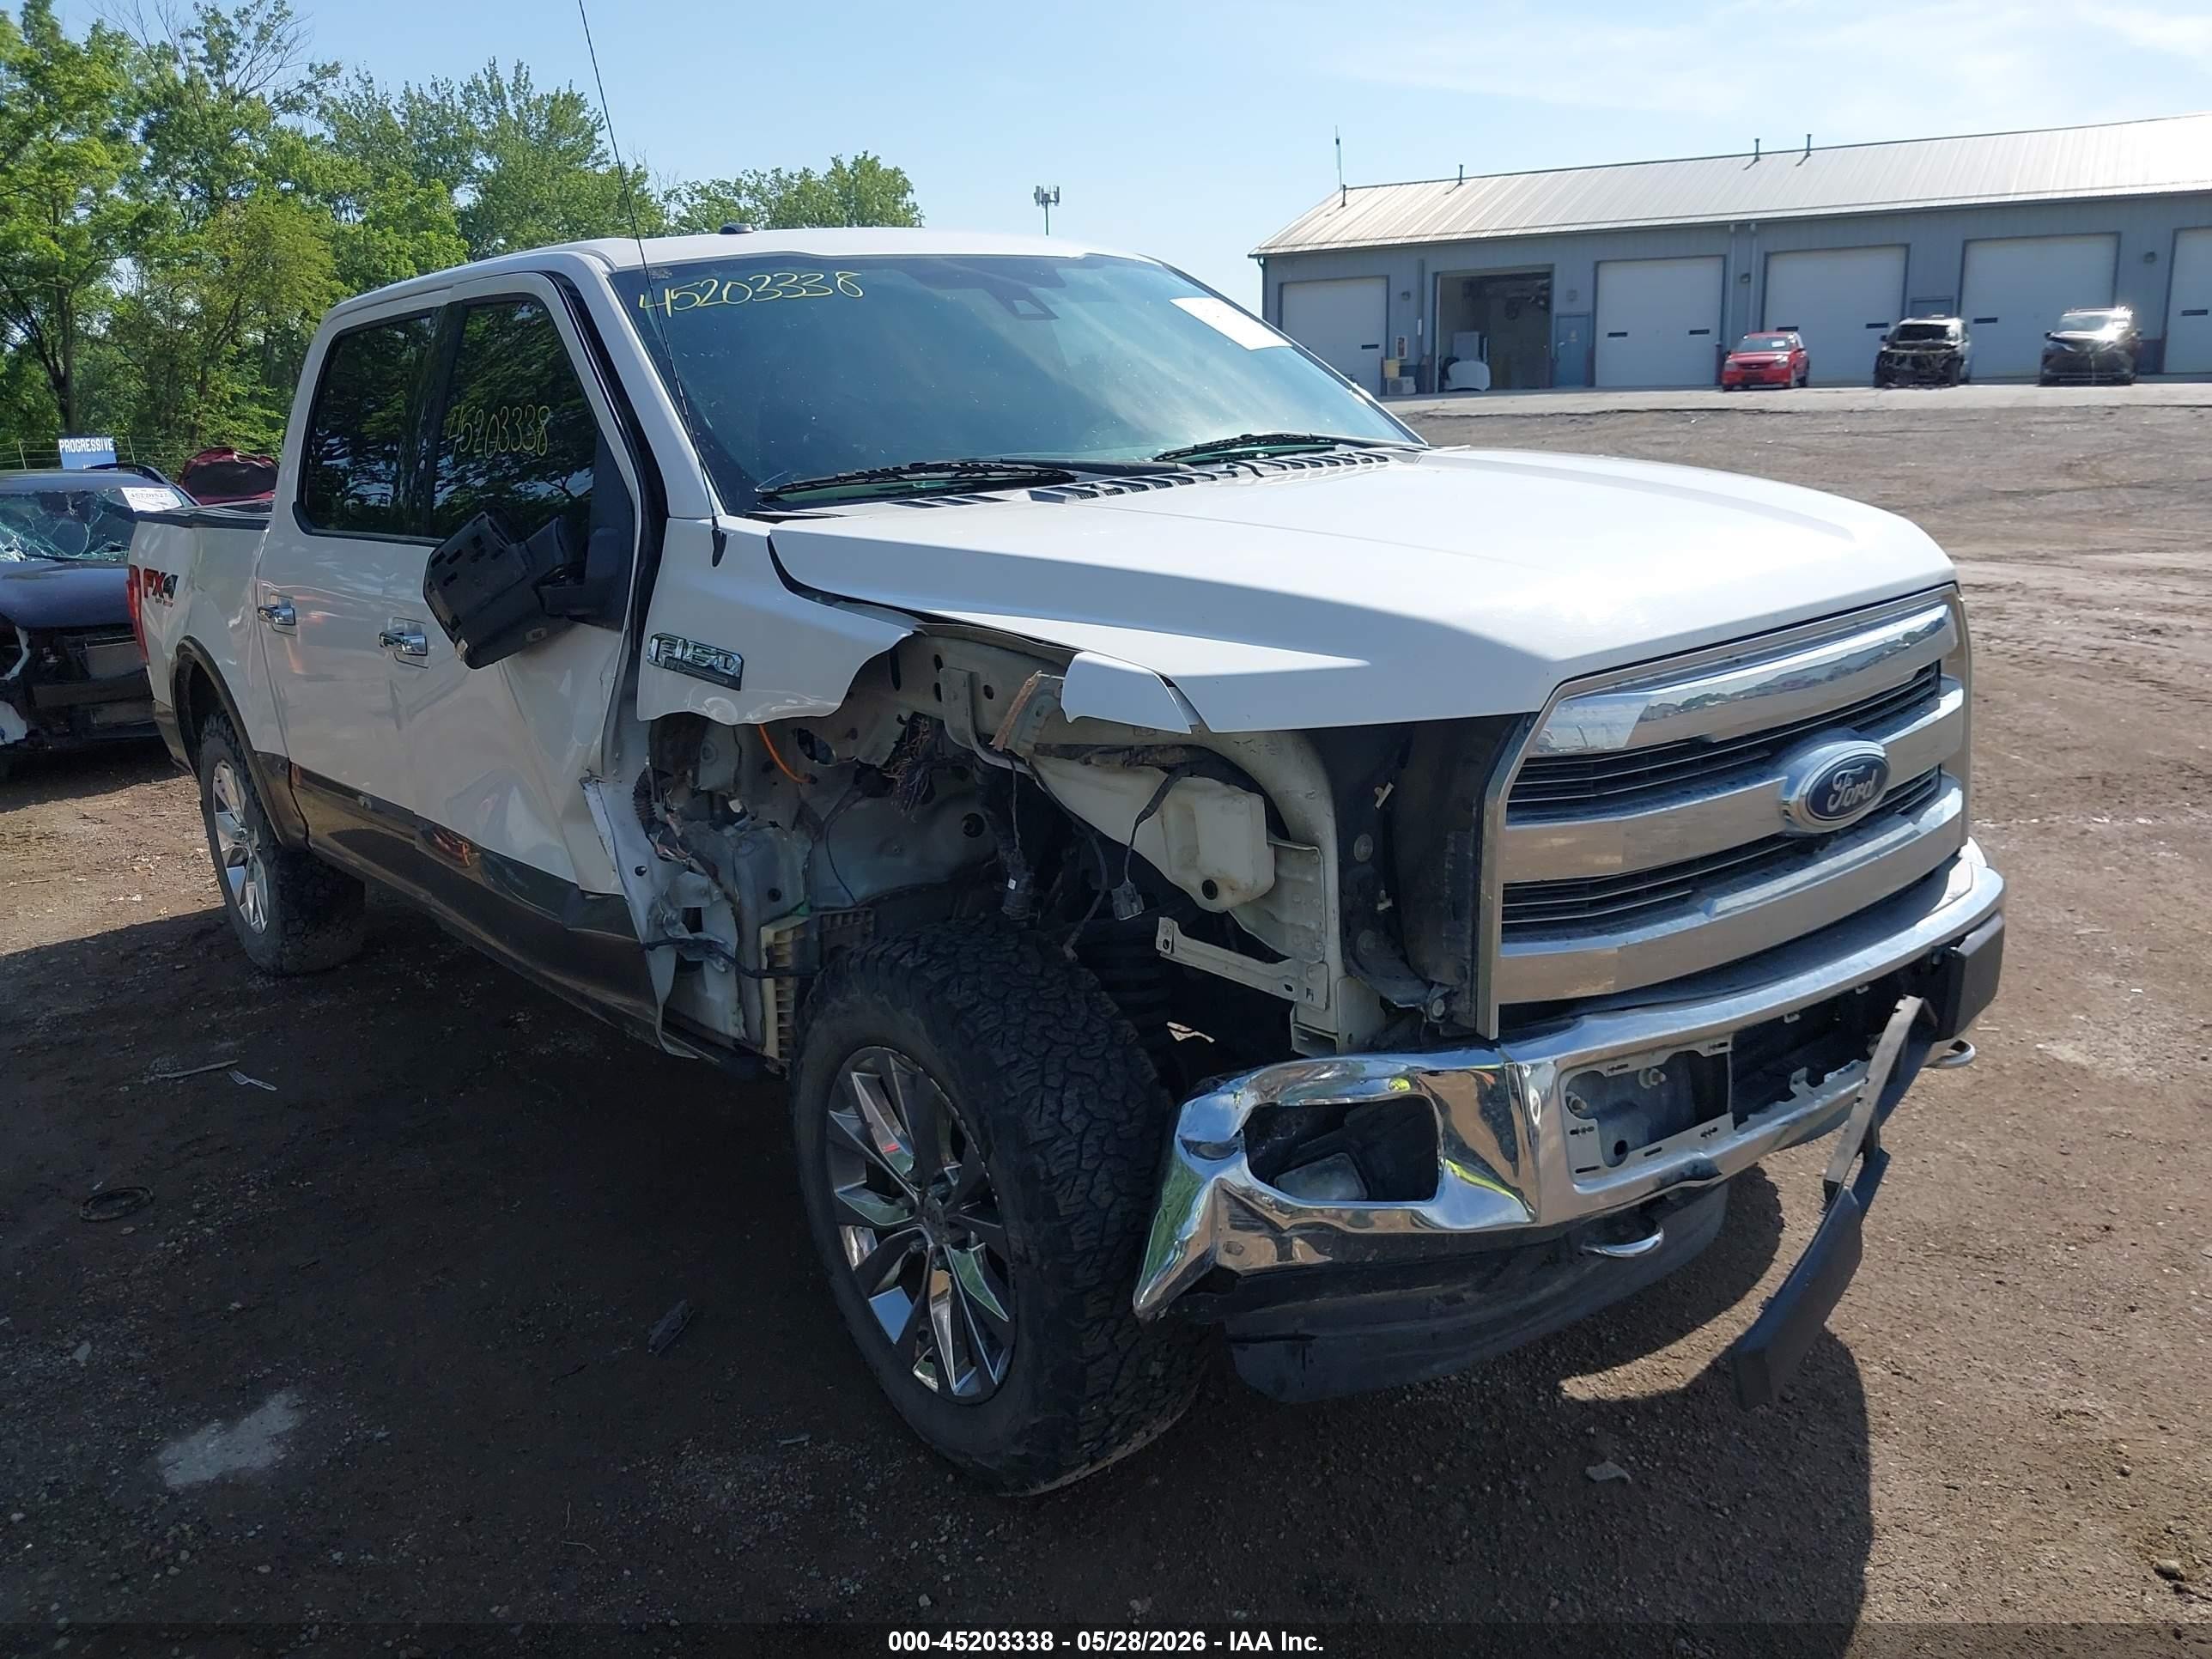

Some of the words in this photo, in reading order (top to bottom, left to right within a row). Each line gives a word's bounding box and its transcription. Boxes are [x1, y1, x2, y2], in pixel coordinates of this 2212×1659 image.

[638, 270, 864, 318] 45203338
[58, 438, 115, 453] PROGRESSIVE
[447, 404, 550, 462] 45203338
[143, 568, 179, 599] FX4
[1826, 764, 1878, 813] Ford
